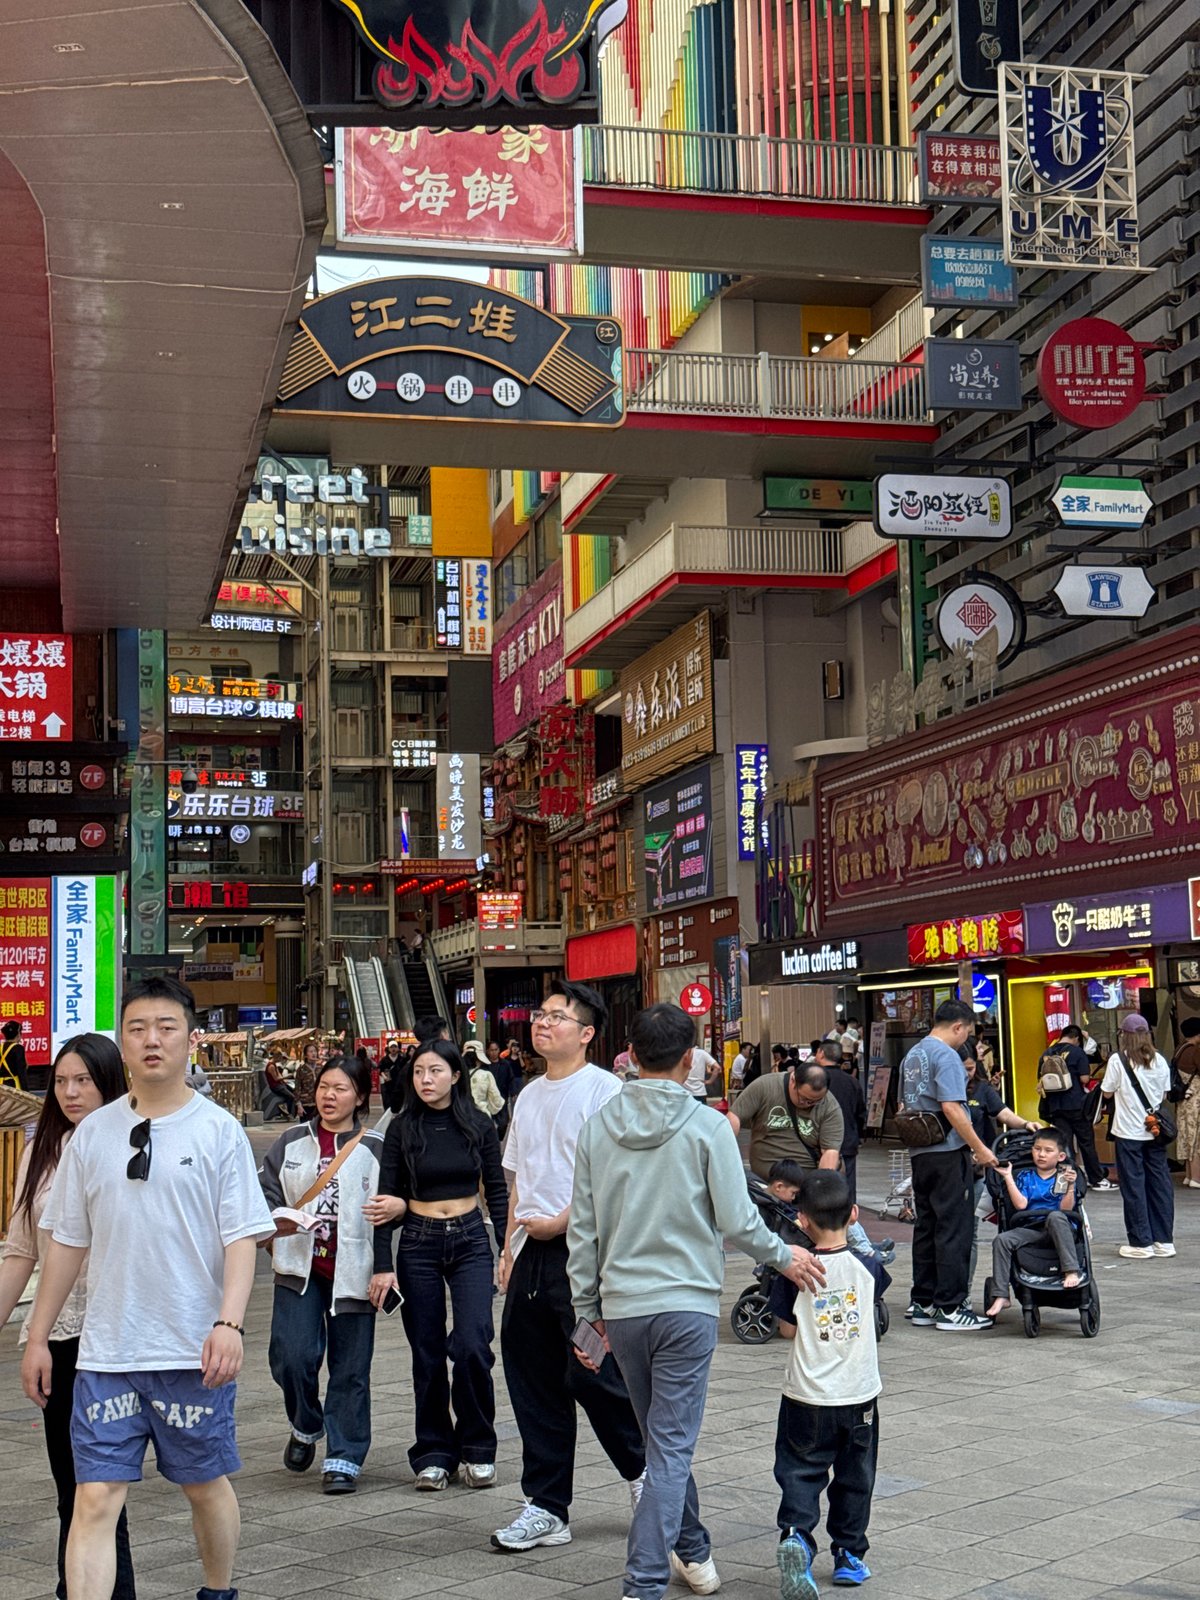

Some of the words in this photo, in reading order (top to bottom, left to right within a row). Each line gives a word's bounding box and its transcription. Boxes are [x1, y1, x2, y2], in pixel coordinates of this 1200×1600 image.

[930, 142, 1000, 160] 很庆幸我们
[931, 159, 1000, 177] 在得意相遇
[400, 166, 519, 221] 海鲜
[931, 246, 1003, 262] 总要去趟重庆
[1010, 242, 1084, 256] International
[1089, 246, 1138, 260] Cineplex
[954, 276, 985, 289] 的晚风
[350, 296, 517, 343] 江二娃
[1053, 344, 1135, 375] NUTS
[352, 375, 516, 402] 火锅串串
[800, 488, 821, 500] DE
[837, 489, 854, 502] YI
[1061, 495, 1090, 512] 全家
[1094, 502, 1144, 514] FamilyMart
[1090, 574, 1119, 583] LAWSON
[1091, 600, 1120, 609] STATION
[211, 615, 273, 632] 设计师酒店
[276, 620, 291, 633] 5F
[170, 697, 243, 717] 博高台球
[259, 700, 295, 719] 棋牌
[391, 740, 406, 748] CC
[83, 772, 102, 783] 7F
[251, 772, 267, 783] 3F
[183, 794, 274, 817] 乐乐台球
[282, 797, 303, 811] 3F
[83, 830, 102, 840] 7F
[141, 829, 154, 853] DE
[141, 870, 154, 890] YI
[66, 881, 89, 925] 全家
[1074, 904, 1136, 932] 一只酸奶牛
[781, 948, 809, 976] luckin
[810, 944, 842, 973] coffee
[1, 970, 45, 988] 天燃气
[61, 928, 83, 1025] FamilyMart
